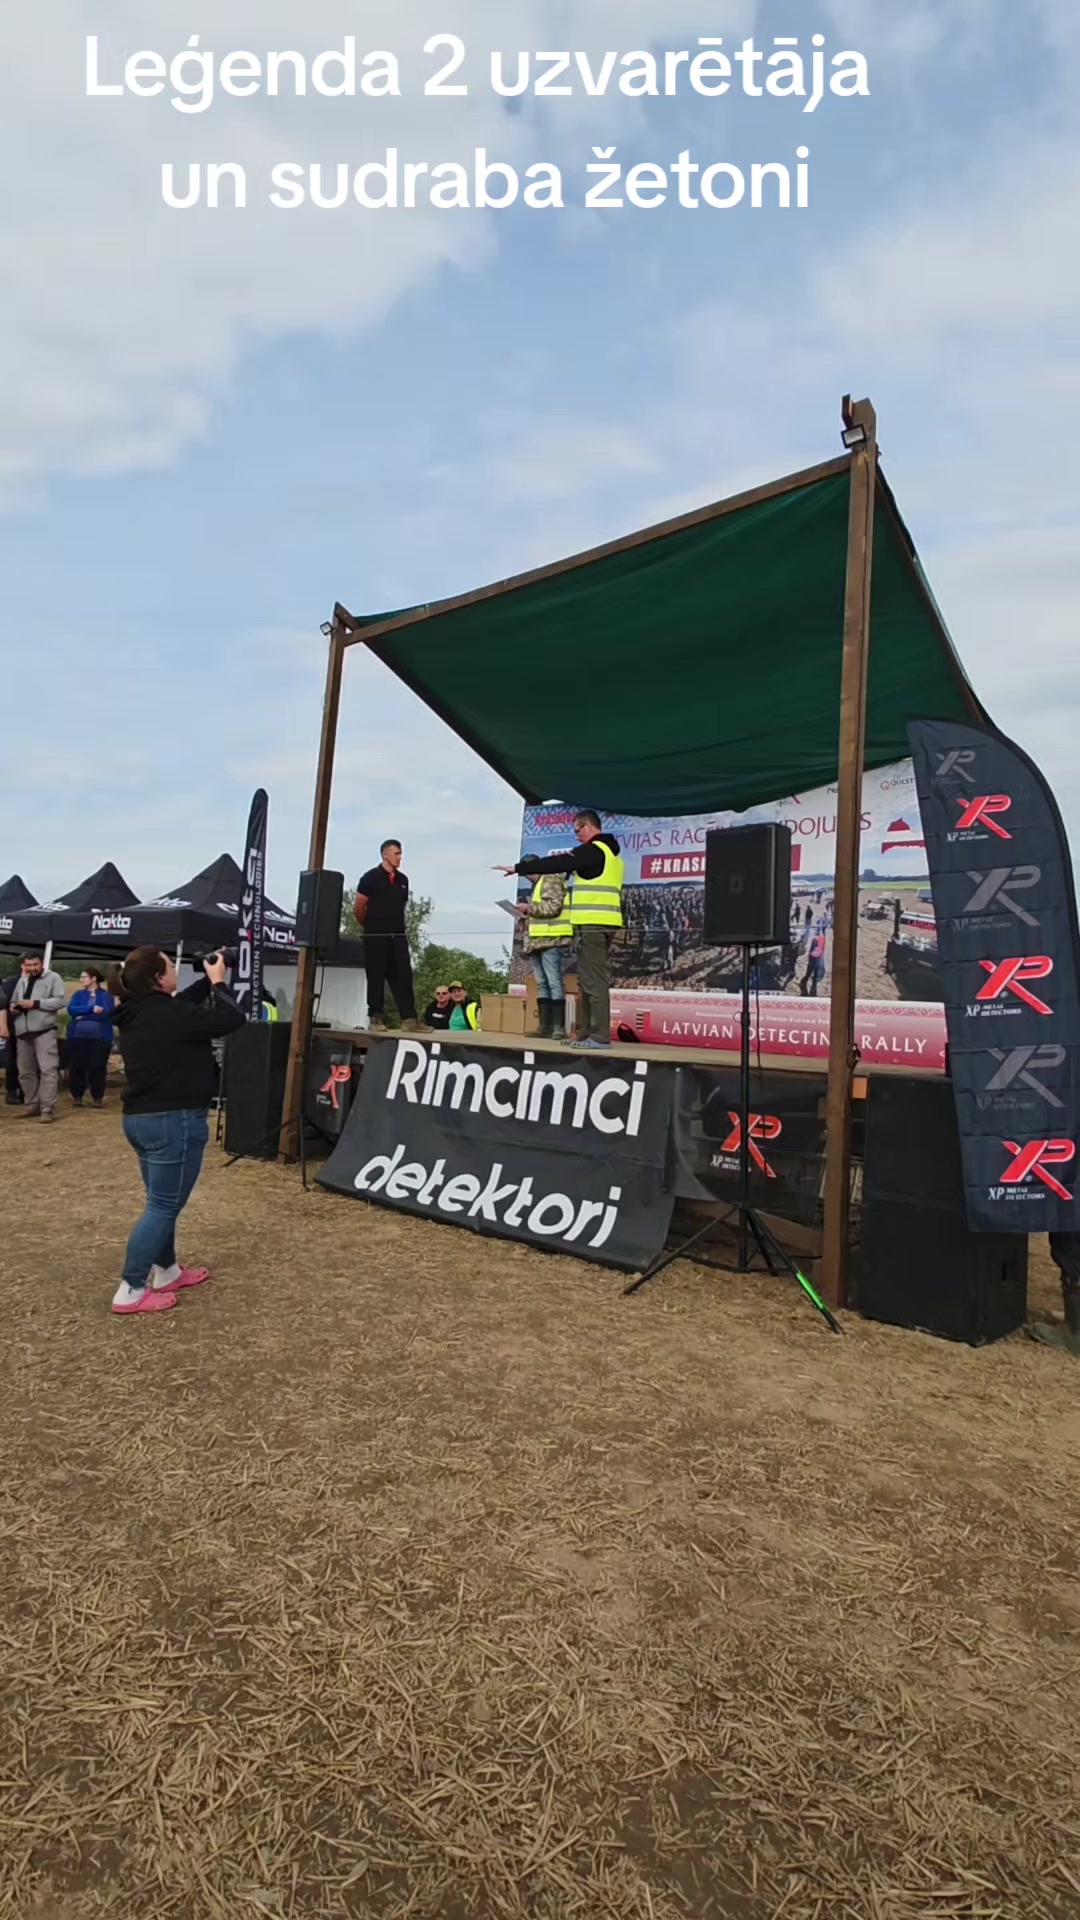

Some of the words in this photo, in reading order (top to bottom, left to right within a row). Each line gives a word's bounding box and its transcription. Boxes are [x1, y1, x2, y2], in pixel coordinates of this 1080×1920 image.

[662, 1020, 733, 1039] LATVIAN
[749, 1027, 831, 1046] DETECTIN
[861, 1034, 927, 1054] RALLY
[386, 1039, 648, 1136] Rimcimci
[354, 1144, 622, 1248] detektori
[1005, 1193, 1046, 1201] DETECTORS
